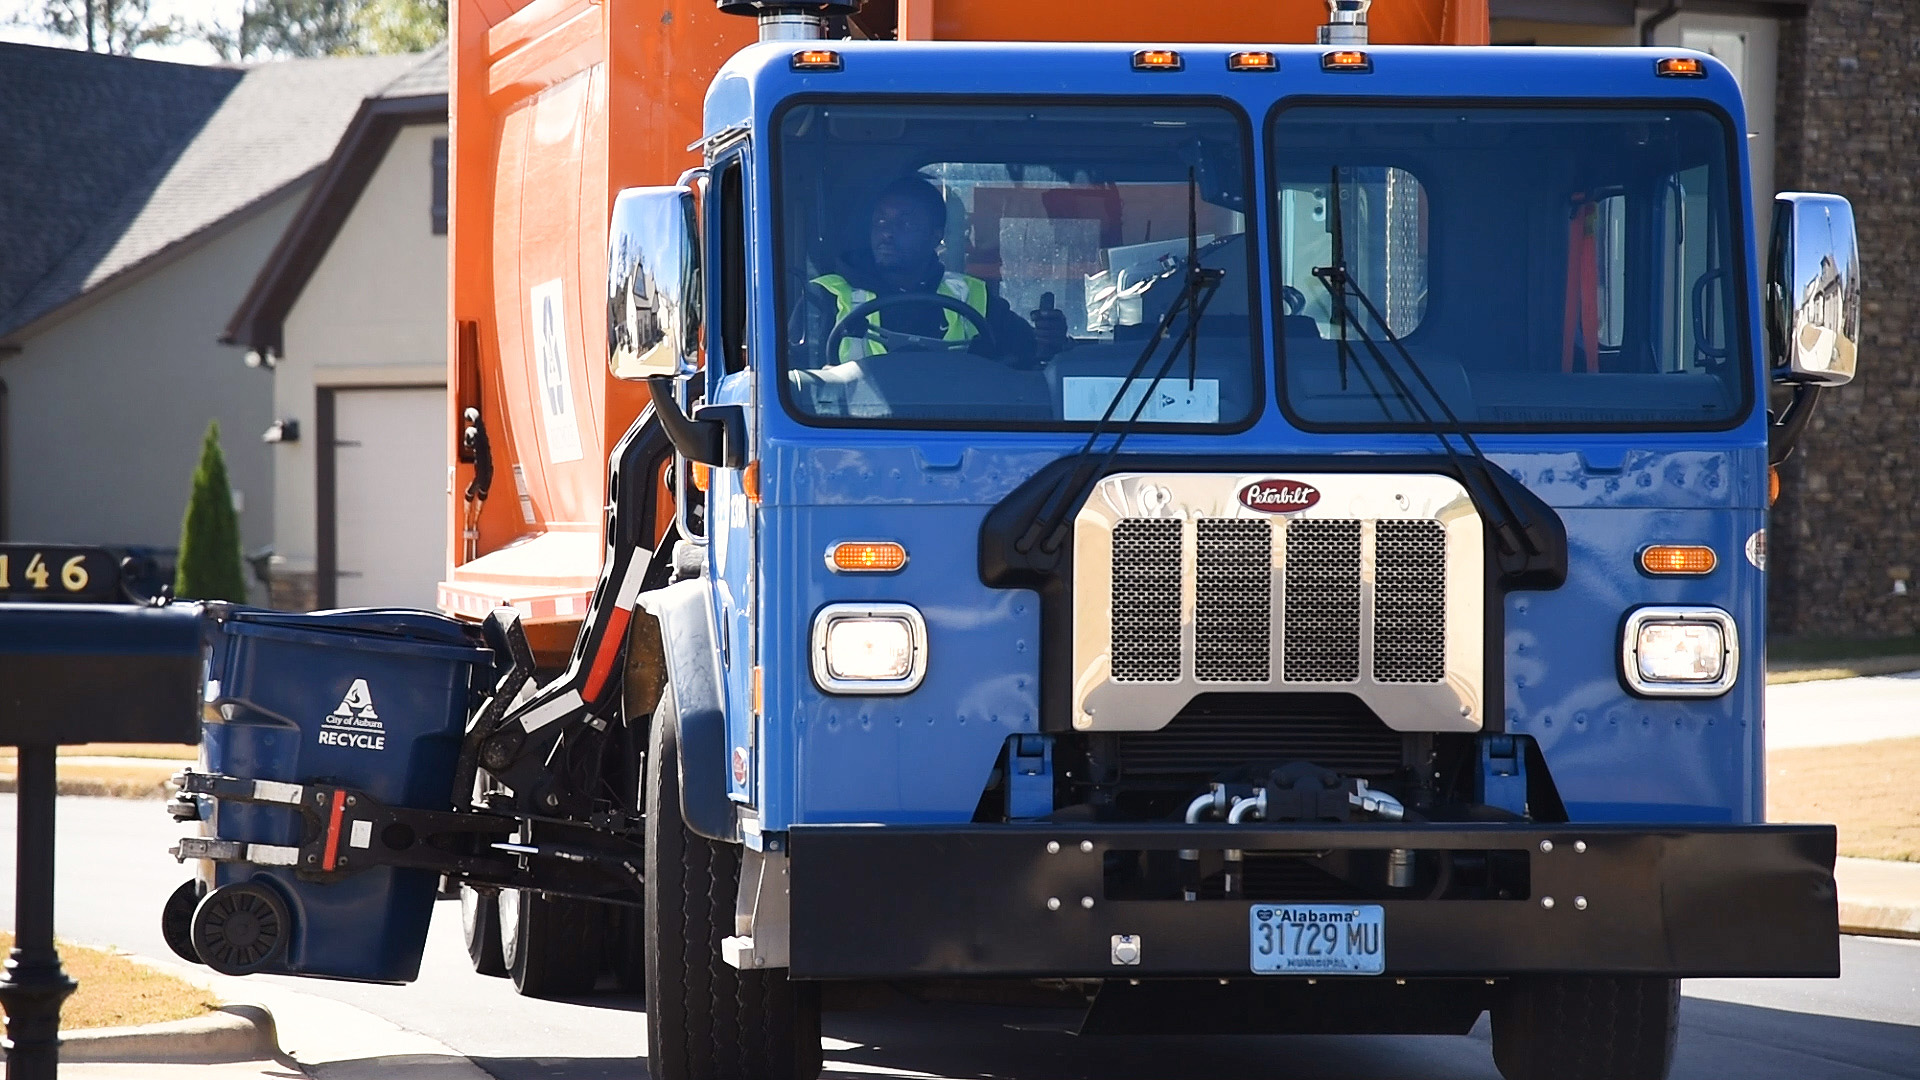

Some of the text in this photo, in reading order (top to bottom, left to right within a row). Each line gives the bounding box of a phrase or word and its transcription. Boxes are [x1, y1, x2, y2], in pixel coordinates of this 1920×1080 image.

[1246, 484, 1315, 506] Peterbilt
[0, 552, 89, 591] 146
[325, 714, 383, 728] City of Auburn
[318, 731, 385, 750] RECYCLE
[1281, 909, 1354, 922] Alabama
[1257, 922, 1379, 956] 31729 MU
